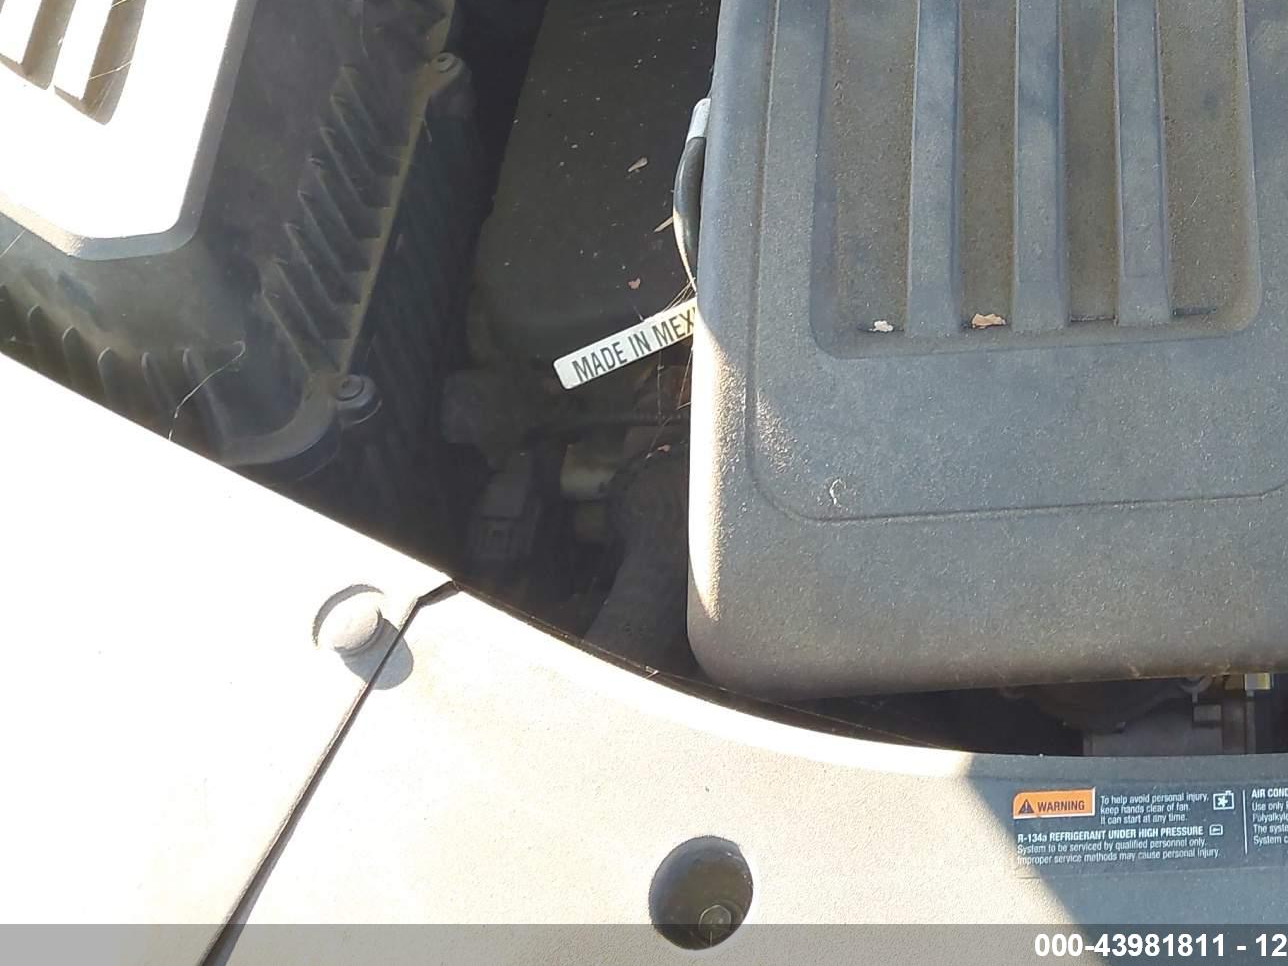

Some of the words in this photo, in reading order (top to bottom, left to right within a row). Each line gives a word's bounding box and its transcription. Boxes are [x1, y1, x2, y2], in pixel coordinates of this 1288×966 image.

[572, 342, 627, 382] MADE
[628, 330, 652, 357] IN
[652, 307, 695, 347] MEX
[1101, 796, 1109, 804] To
[1112, 795, 1127, 805] help
[1130, 794, 1149, 803] avoid
[1152, 793, 1184, 803] personal
[1252, 789, 1265, 799] AIR
[1038, 800, 1085, 812] WARNING
[1101, 804, 1119, 815] keep
[1121, 804, 1144, 814] hands
[1146, 804, 1164, 812] clear
[1167, 803, 1174, 811] of
[1176, 802, 1190, 811] fan.
[1252, 802, 1266, 811] Use
[1268, 802, 1283, 811] only
[1108, 817, 1121, 825] can
[1124, 814, 1141, 823] start
[1143, 815, 1150, 823] at
[1153, 814, 1166, 823] any
[1169, 813, 1187, 821] time.
[1018, 834, 1047, 843] R-134a
[1050, 831, 1106, 842] REFRIGERANT
[1108, 829, 1136, 839] UNDER
[1139, 826, 1158, 838] HIGH
[1161, 826, 1203, 838] PRESSURE
[1253, 824, 1267, 833] The
[1018, 844, 1046, 855] System
[1048, 844, 1056, 853] to
[1058, 843, 1067, 852] be
[1070, 842, 1102, 851] serviced
[1104, 841, 1113, 851] by
[1115, 839, 1147, 850] qualified
[1150, 838, 1187, 849] personnel
[1189, 837, 1207, 847] only.
[1253, 836, 1282, 846] System
[1055, 855, 1082, 864] service
[1084, 853, 1117, 862] methods
[1119, 852, 1136, 861] may
[1138, 851, 1160, 859] cause
[1162, 849, 1195, 859] personal
[1198, 848, 1220, 858] injury.
